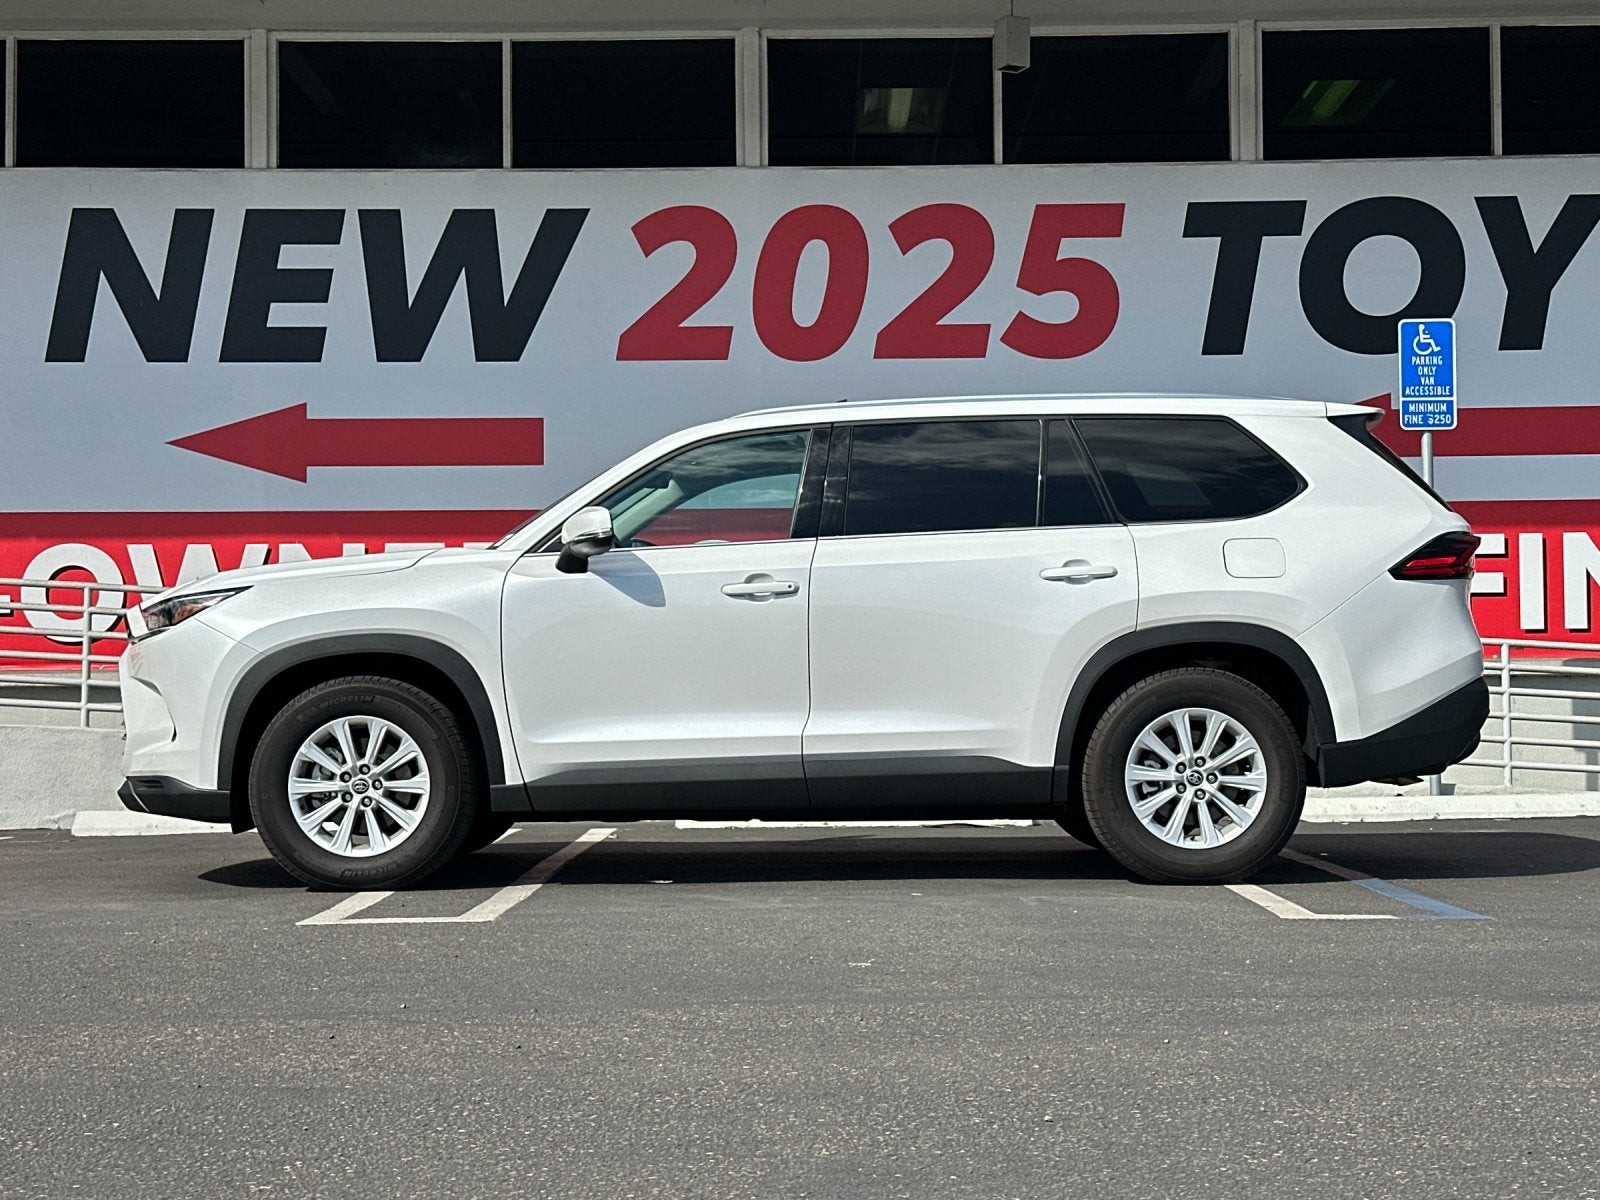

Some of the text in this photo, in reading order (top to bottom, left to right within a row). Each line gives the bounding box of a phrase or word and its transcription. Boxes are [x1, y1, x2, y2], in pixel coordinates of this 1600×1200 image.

[45, 194, 1600, 363] NEW 2025 TOY
[1411, 355, 1443, 366] PARKING
[1417, 366, 1437, 376] ONLY
[1420, 376, 1435, 386] VAN
[1405, 386, 1451, 396] ACCESSIBLE
[1408, 402, 1447, 413] MINIMUM
[1404, 413, 1452, 425] FINE $250
